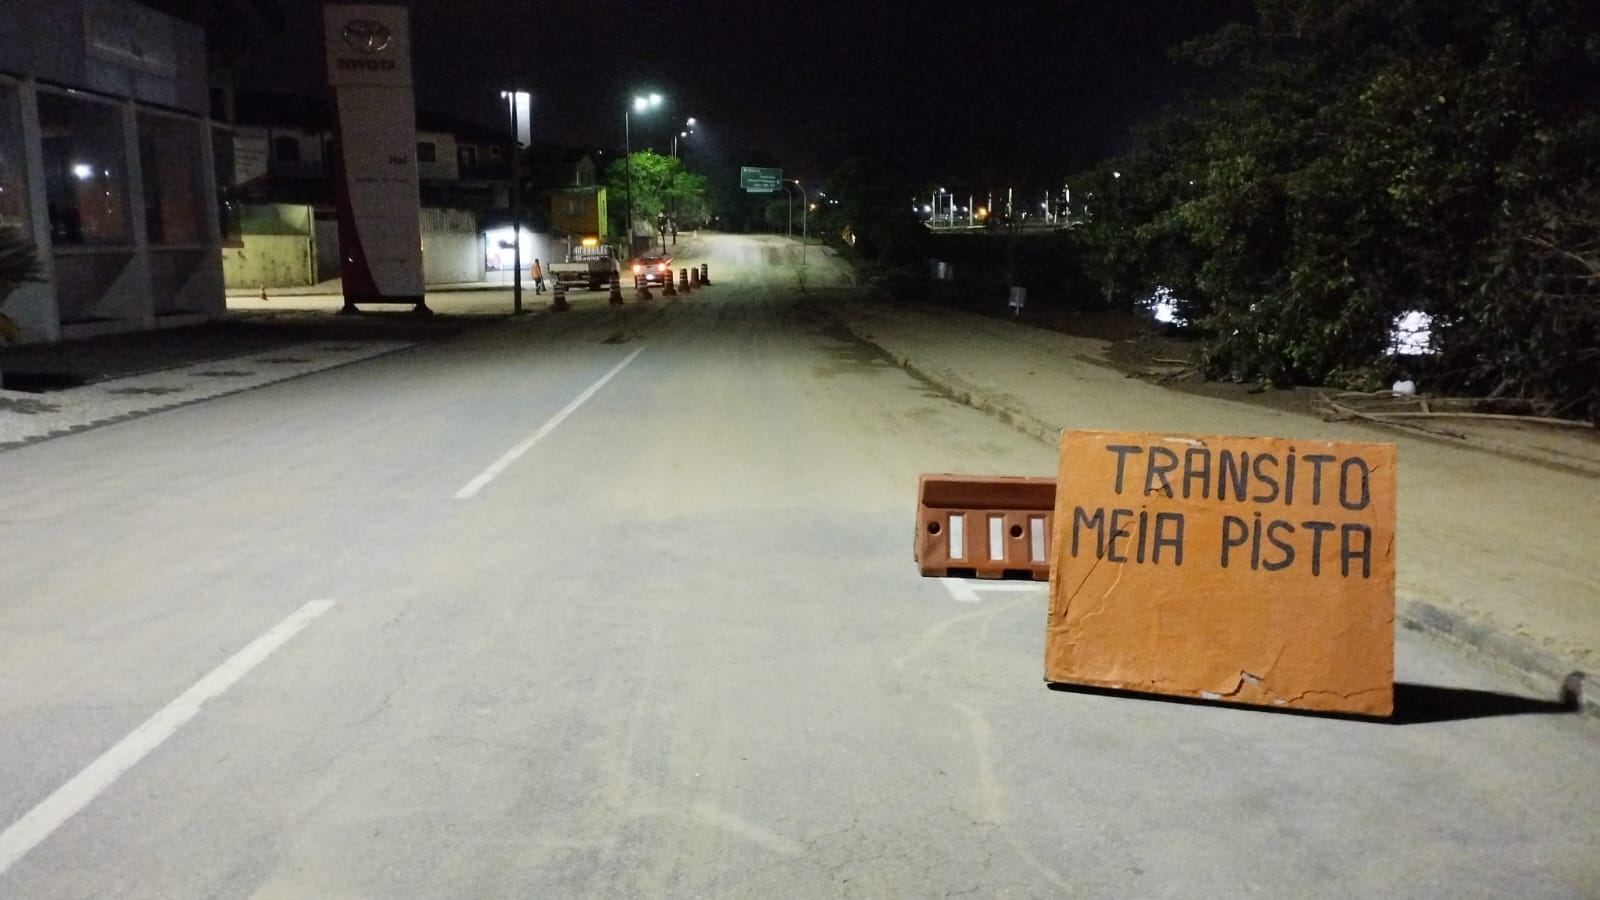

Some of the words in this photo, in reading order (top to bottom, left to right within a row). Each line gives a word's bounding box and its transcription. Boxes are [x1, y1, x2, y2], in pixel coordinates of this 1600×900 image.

[336, 58, 396, 71] TOYOTA
[1071, 505, 1185, 566] MEIA
[1220, 511, 1372, 579] PISTA
